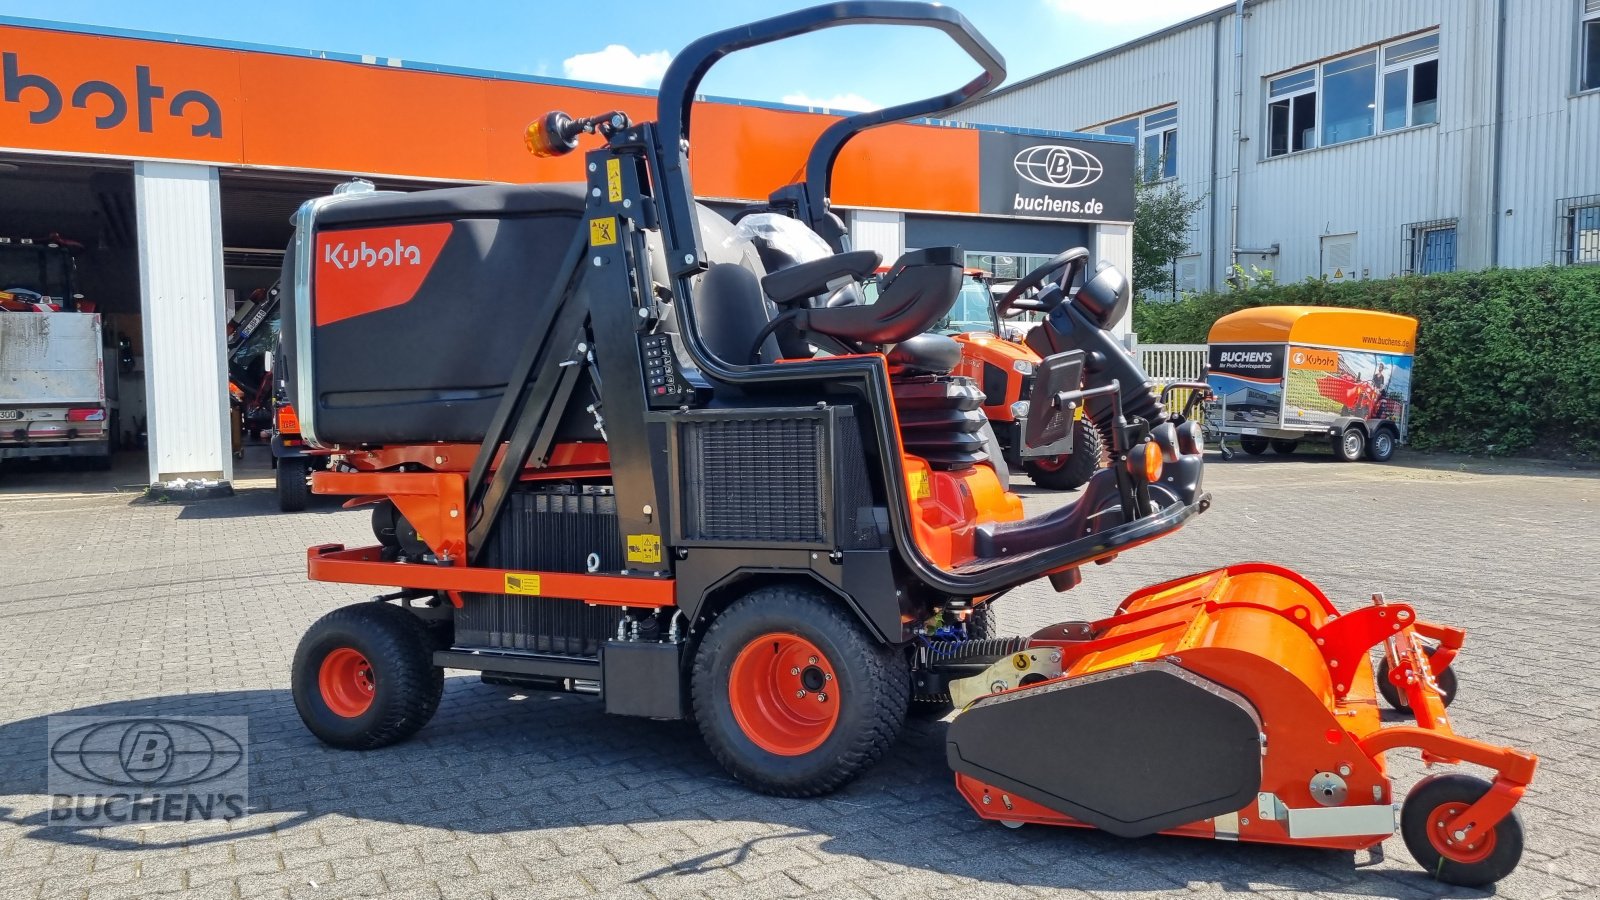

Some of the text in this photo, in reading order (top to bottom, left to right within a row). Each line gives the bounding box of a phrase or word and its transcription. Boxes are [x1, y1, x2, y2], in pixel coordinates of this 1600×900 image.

[1013, 193, 1104, 215] buchens.de
[325, 239, 421, 270] Kubota
[1362, 336, 1410, 348] www.buchens.de
[1220, 351, 1273, 363] BUCHEN'S
[1306, 354, 1335, 367] Kubota
